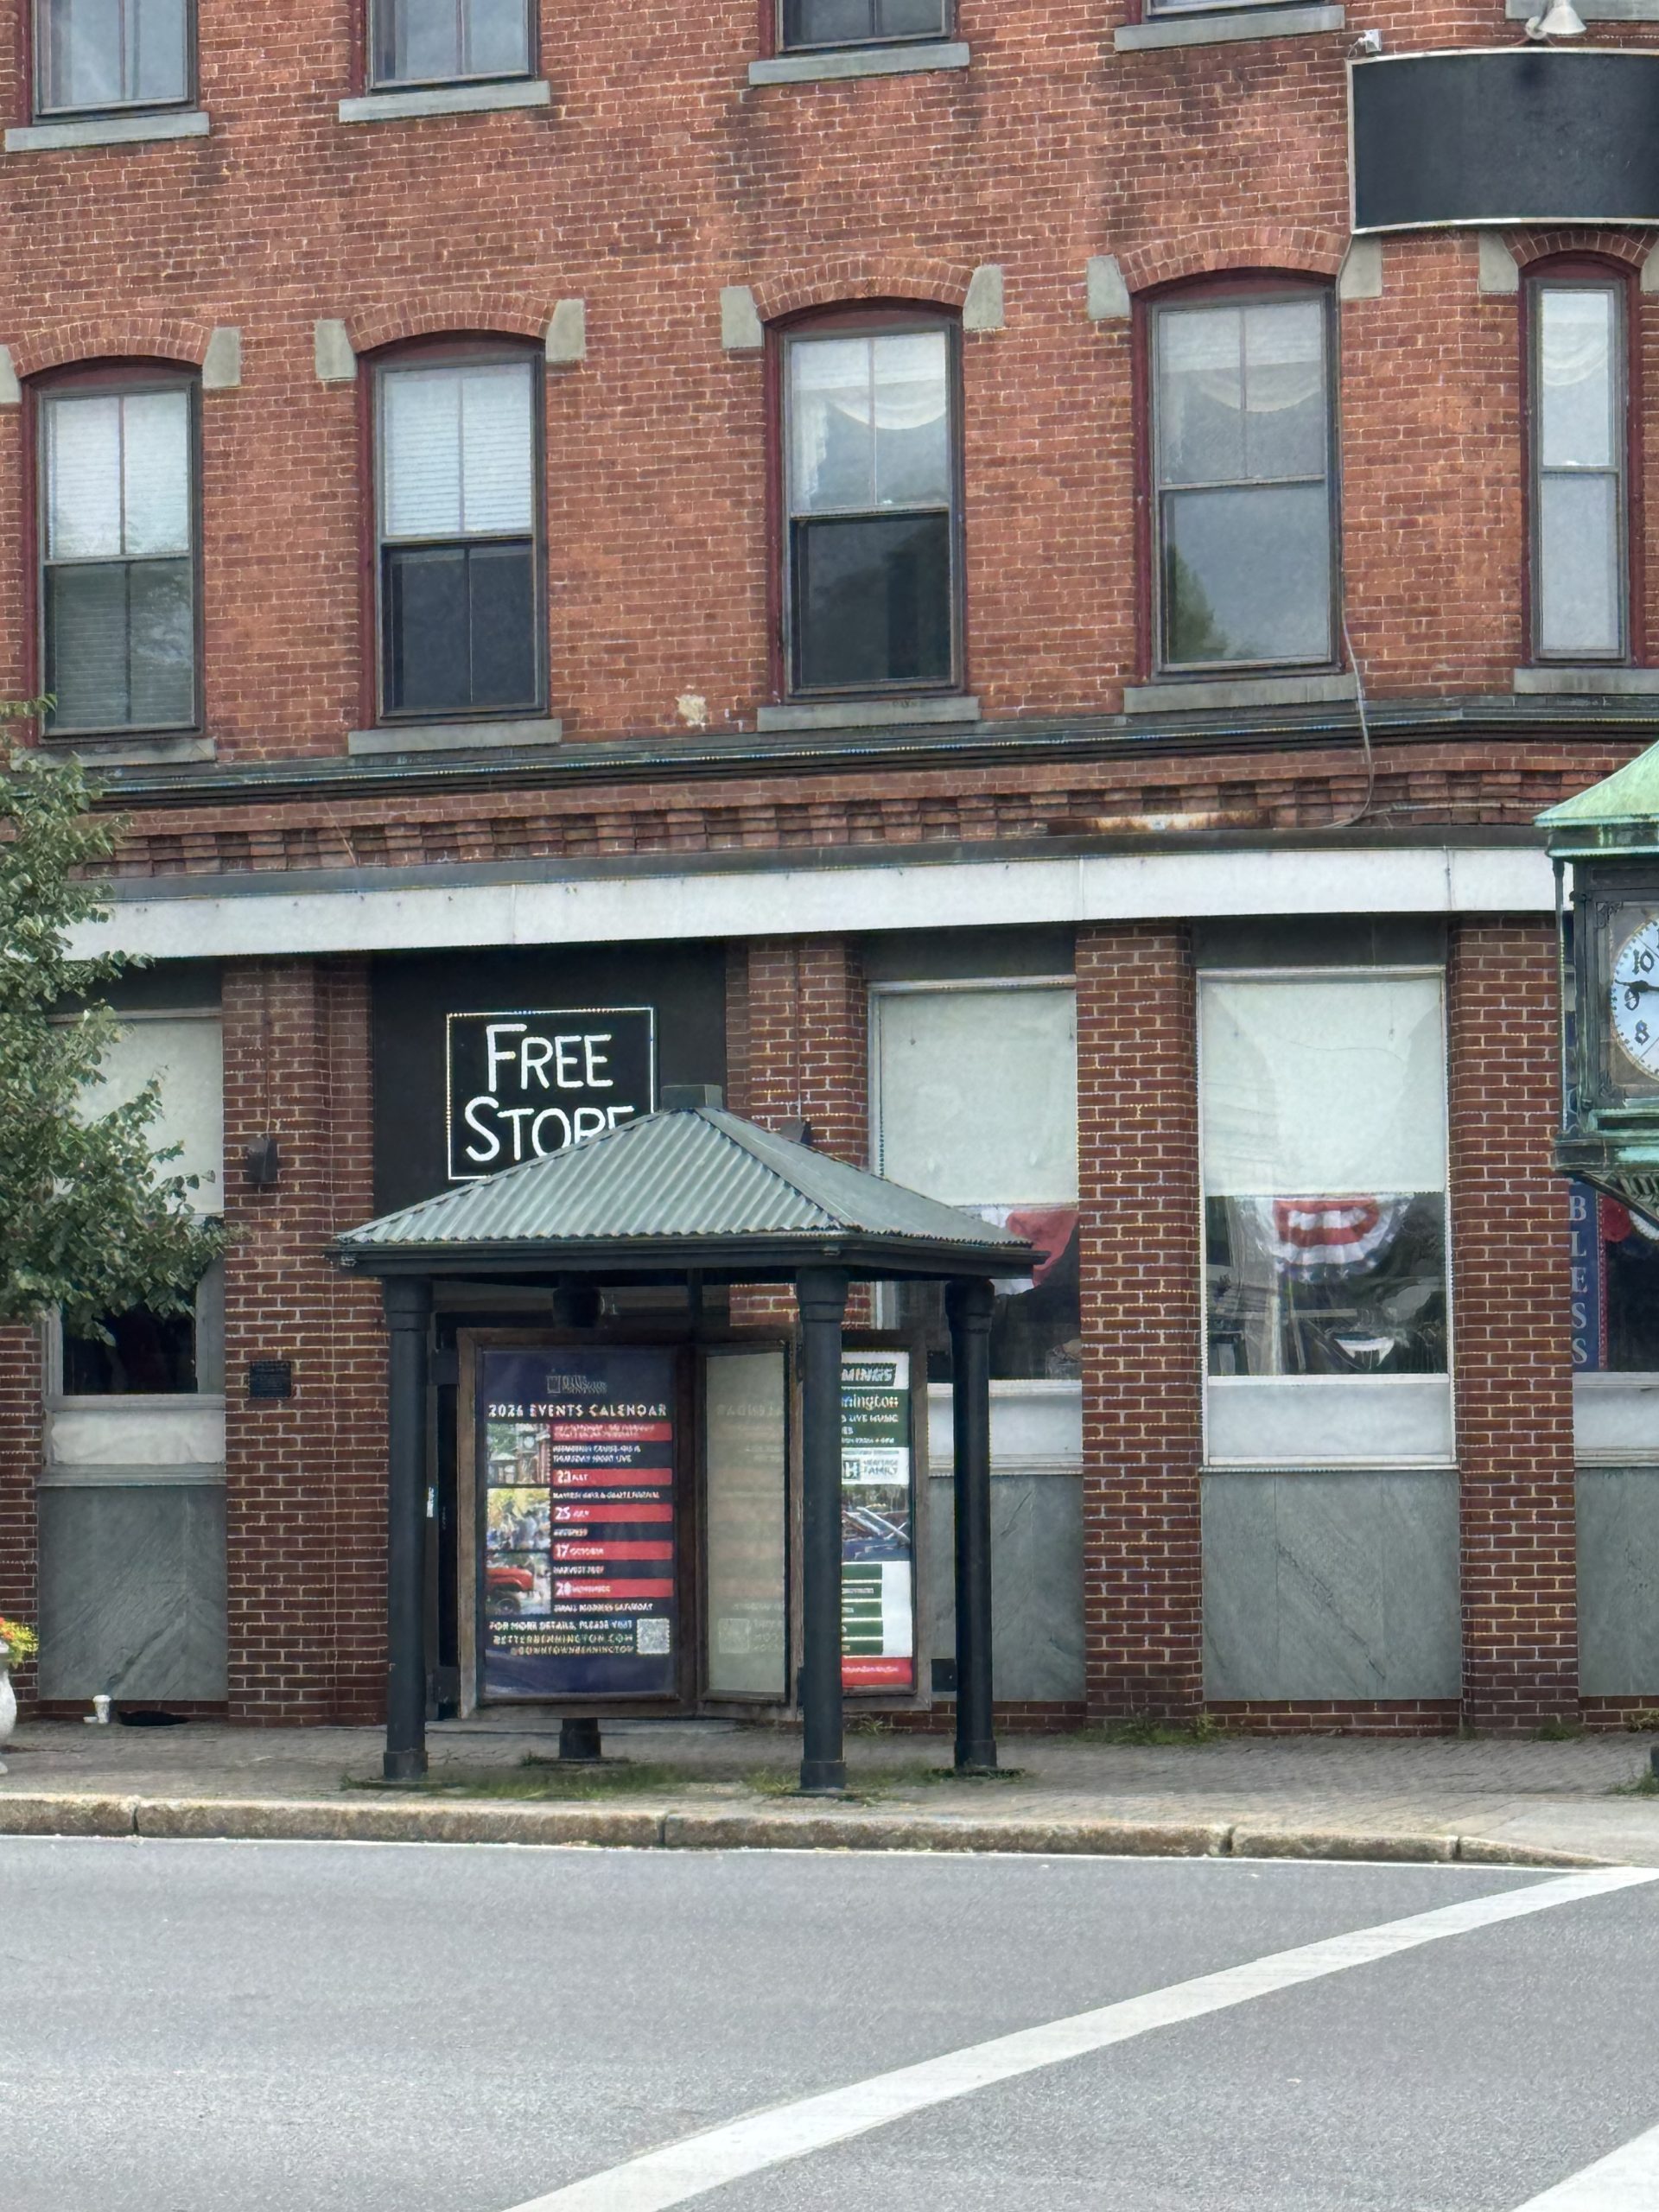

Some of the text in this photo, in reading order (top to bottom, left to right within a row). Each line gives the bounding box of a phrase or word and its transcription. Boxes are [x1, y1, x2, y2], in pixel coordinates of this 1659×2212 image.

[1632, 949, 1655, 975] 10
[1624, 988, 1640, 1011] 9
[1634, 1020, 1650, 1045] 8
[486, 1023, 613, 1092] FREE
[1568, 1195, 1588, 1363] BLESS
[841, 1368, 893, 1382] MINGS
[530, 1404, 583, 1417] EVENTS
[588, 1403, 667, 1417] CALENDAR
[841, 1393, 899, 1411] nington
[555, 1506, 570, 1520] 25
[556, 1544, 569, 1557] 17
[489, 1621, 509, 1630] FOR
[510, 1621, 537, 1630] MORE
[579, 1620, 609, 1630] PLEASE
[612, 1619, 632, 1629] VISIT
